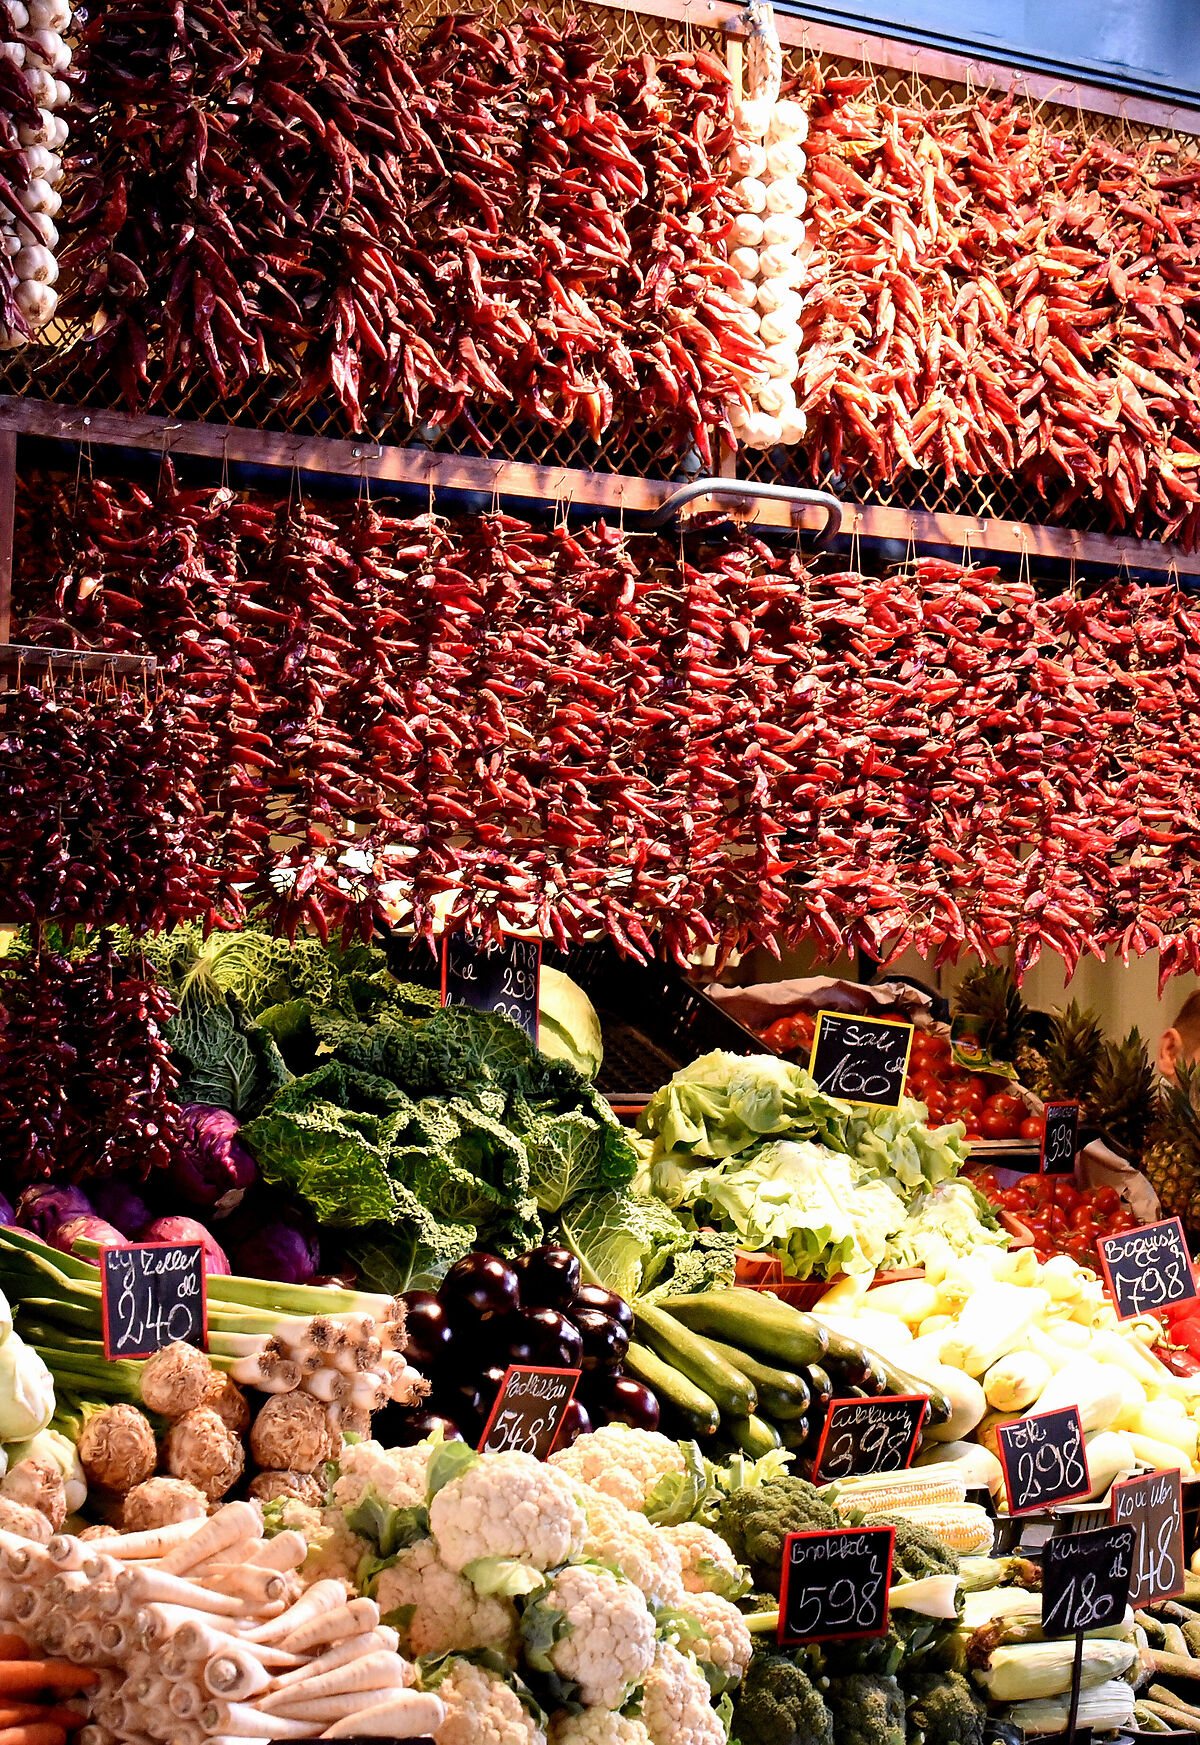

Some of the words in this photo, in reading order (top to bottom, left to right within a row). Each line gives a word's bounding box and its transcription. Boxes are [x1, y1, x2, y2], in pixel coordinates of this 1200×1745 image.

[818, 1053, 891, 1097] 160
[1115, 1261, 1185, 1317] 798
[116, 1286, 193, 1350] 240
[790, 1578, 877, 1634] 598
[1041, 1571, 1115, 1629] 180
